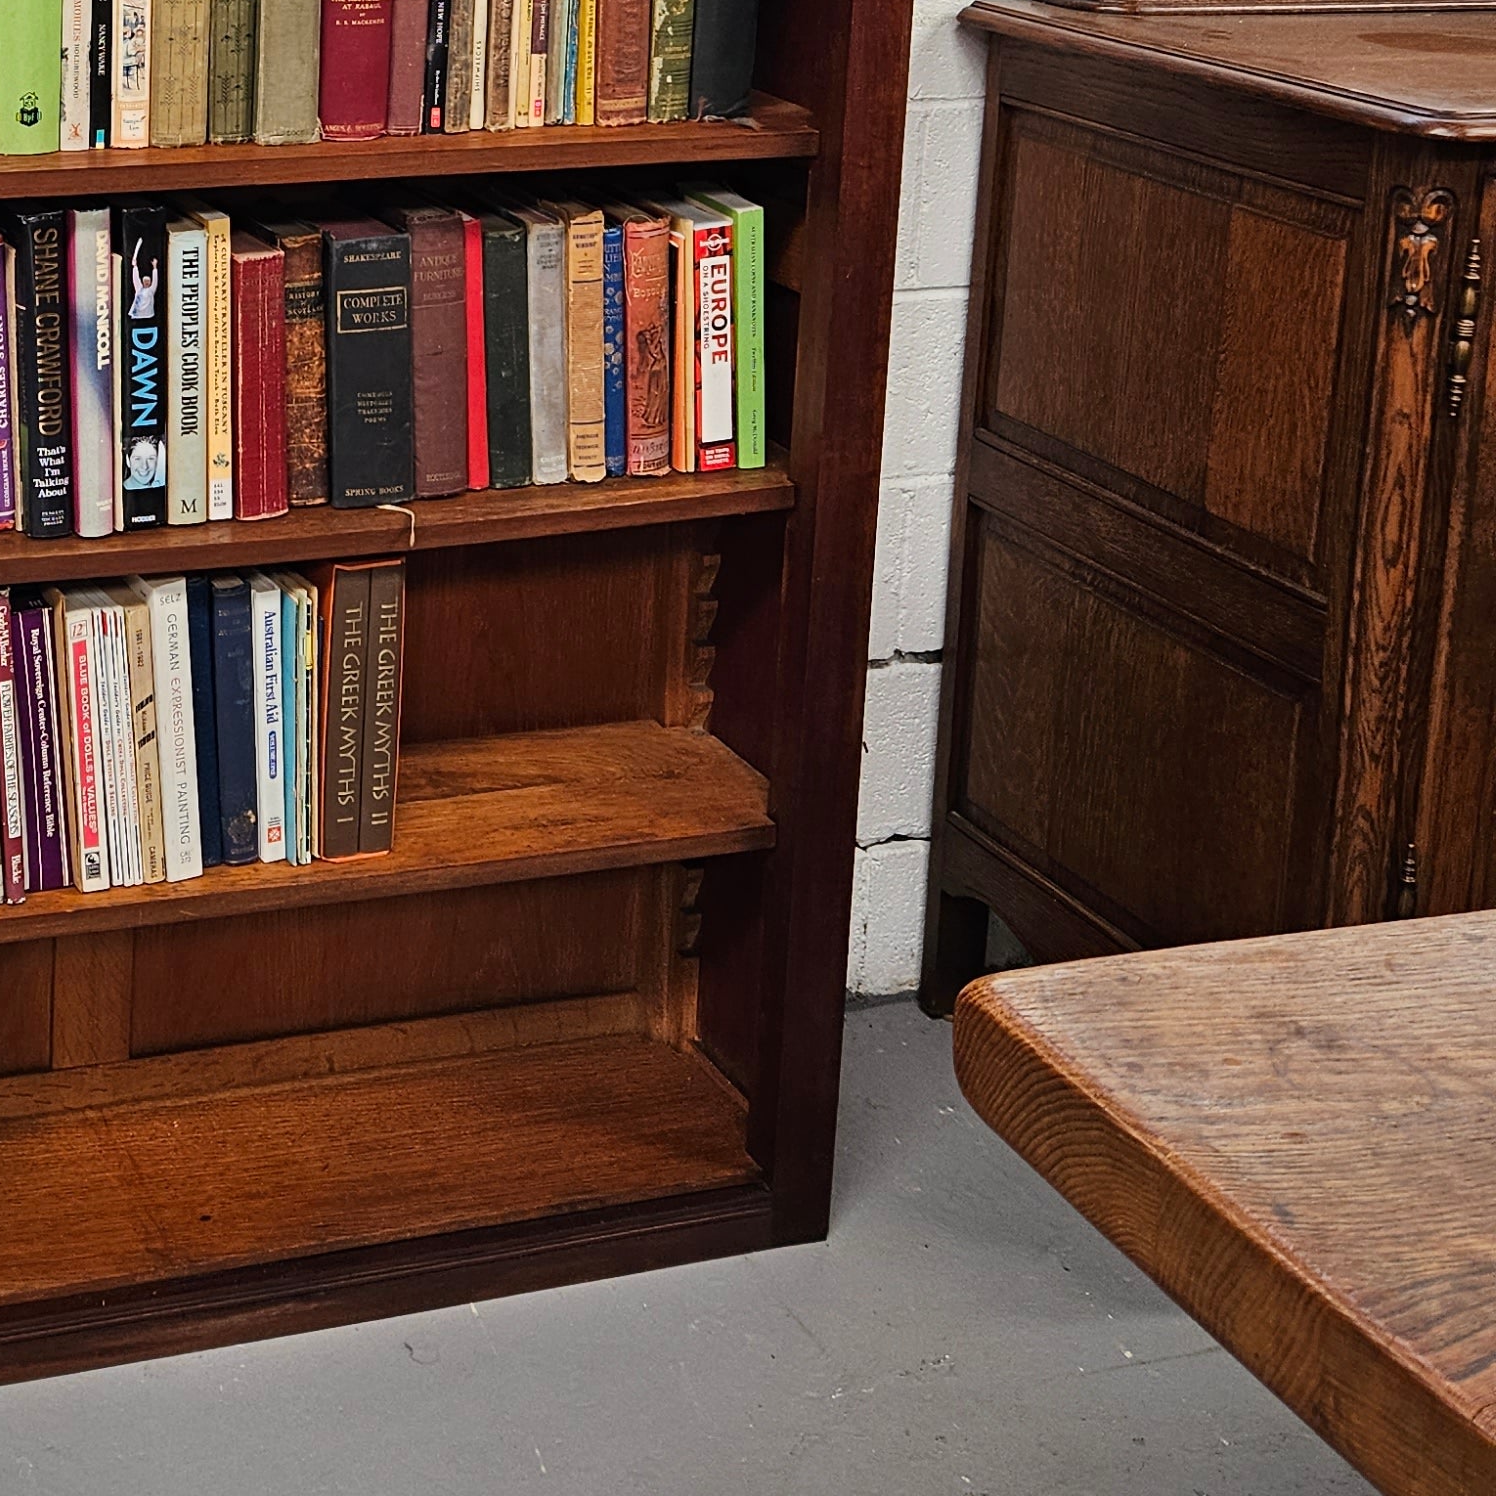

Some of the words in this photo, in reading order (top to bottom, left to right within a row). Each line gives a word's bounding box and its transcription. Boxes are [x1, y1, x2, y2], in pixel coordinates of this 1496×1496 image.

[437, 2, 445, 19] NEW
[221, 234, 226, 243] A
[33, 228, 59, 306] SHANE
[182, 247, 199, 279] THE
[703, 266, 709, 279] ON
[182, 283, 200, 349] PEOPLES'
[343, 293, 403, 310] COMPLETE
[352, 311, 397, 325] WORKS
[711, 263, 728, 365] EUROPE
[36, 312, 63, 436] CRAWFORD
[131, 326, 158, 427] DAWN
[181, 352, 199, 392] COOK
[222, 372, 227, 383] IN
[181, 395, 198, 436] BOOK
[32, 476, 69, 487] Talking
[37, 487, 67, 498] About
[379, 595, 398, 644] THE
[167, 613, 179, 670] GERMAN
[264, 611, 278, 671] Australian
[266, 673, 278, 702] First
[375, 649, 395, 716] GREEK
[171, 677, 186, 775] EXPRESSIONIST
[266, 704, 279, 724] Aid
[372, 721, 391, 800] MYTHS
[177, 782, 190, 844] PAINTING
[371, 812, 388, 825] II
